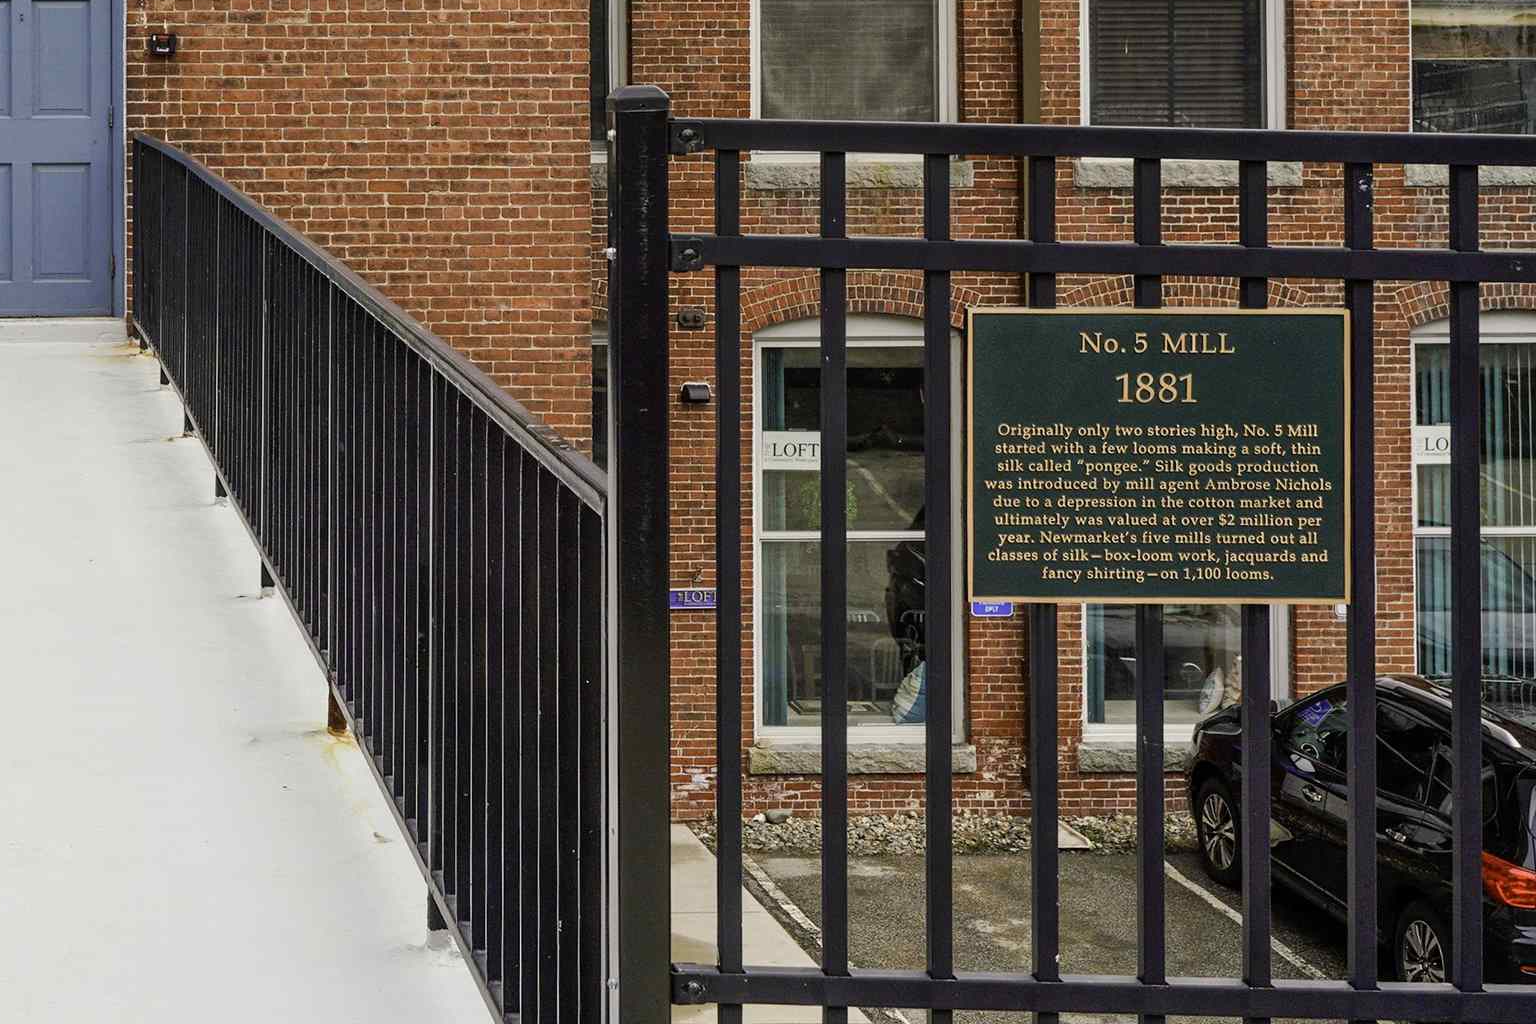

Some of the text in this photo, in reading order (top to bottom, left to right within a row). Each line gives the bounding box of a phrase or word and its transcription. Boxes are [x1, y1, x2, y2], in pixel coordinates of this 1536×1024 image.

[1079, 332, 1236, 354] No. 5 MILL
[1115, 372, 1198, 404] 1881
[997, 423, 1319, 441] Originally only two stories high, No. 5 Mill
[772, 442, 820, 457] LOFT
[994, 441, 1322, 459] started with a few looms making a soft, thin
[1425, 437, 1450, 452] LO
[997, 458, 1025, 472] silk
[1028, 459, 1072, 472] called
[1155, 459, 1184, 473] Silk
[1188, 459, 1233, 477] goods
[1236, 459, 1319, 477] production
[984, 476, 1332, 494] was introduced by mill agent Ambrose Nichols
[993, 494, 1324, 512] due to a depression in the cotton market and
[994, 512, 1323, 530] ultimately was valued at over $2 million per
[997, 533, 1035, 547] year.
[1142, 530, 1171, 544] five
[1174, 531, 1212, 544] mills
[1215, 531, 1266, 545] turned
[1270, 532, 1295, 545] out
[1298, 531, 1318, 545] all
[987, 547, 1039, 562] classes
[1042, 548, 1059, 562] of
[1177, 548, 1221, 564] work,
[1224, 549, 1297, 566] jacquards
[1300, 549, 1329, 563] and
[1041, 566, 1082, 584] fancy
[1183, 566, 1222, 582] 1,100
[1225, 567, 1274, 581] looms.
